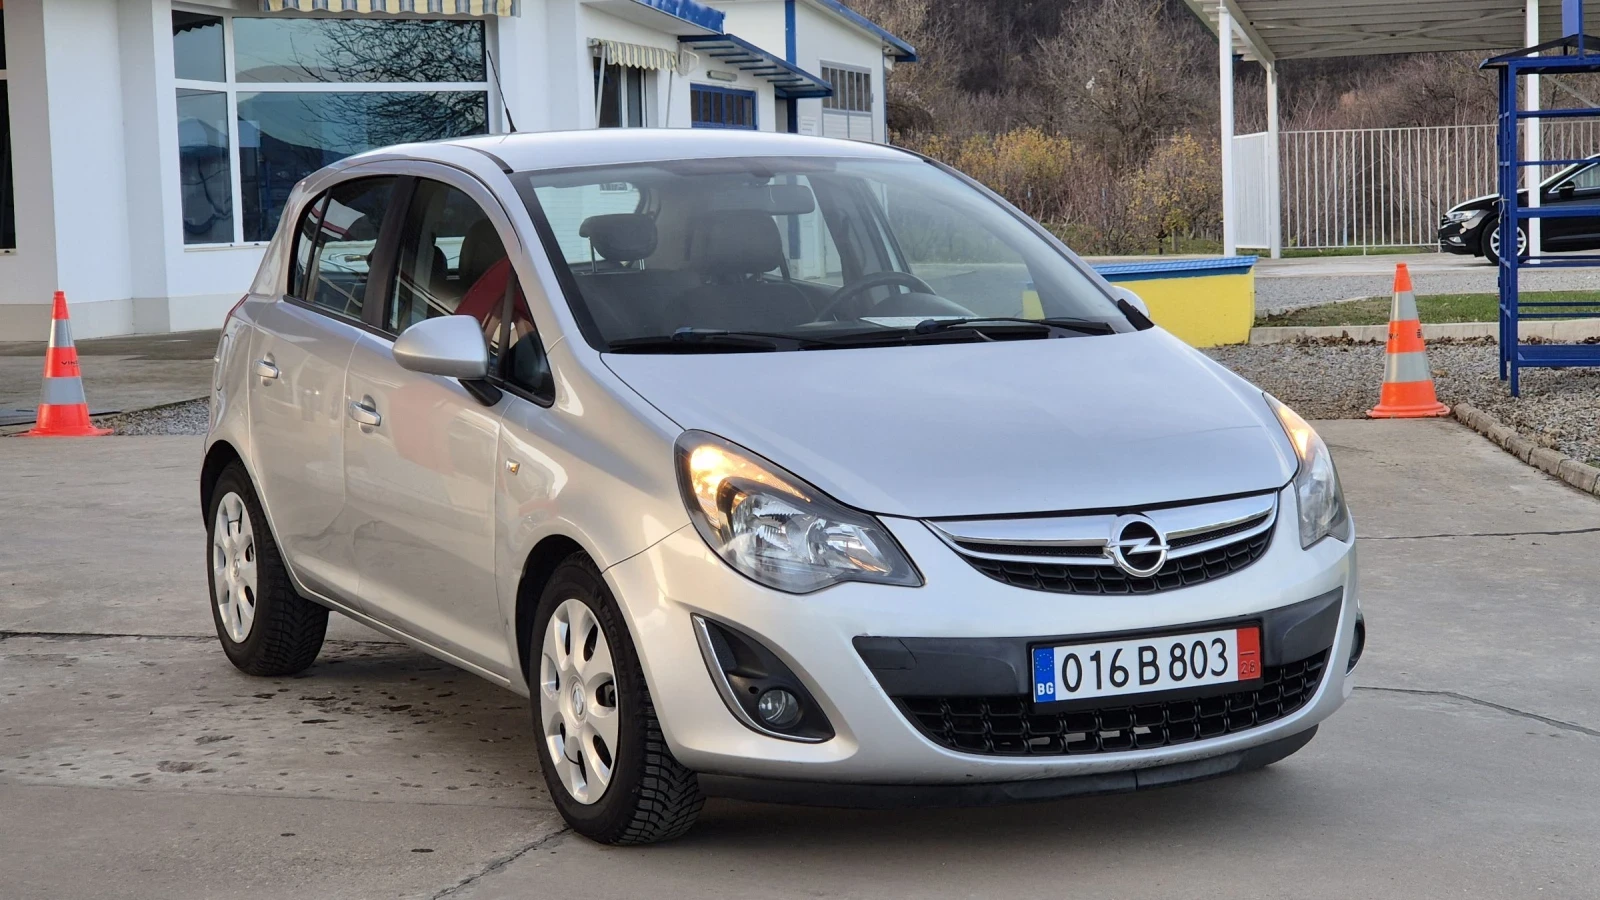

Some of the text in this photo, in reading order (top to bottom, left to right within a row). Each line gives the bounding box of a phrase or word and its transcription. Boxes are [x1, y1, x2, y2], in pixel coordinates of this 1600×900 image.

[1062, 638, 1228, 693] 016 B 803
[1037, 682, 1054, 695] BG
